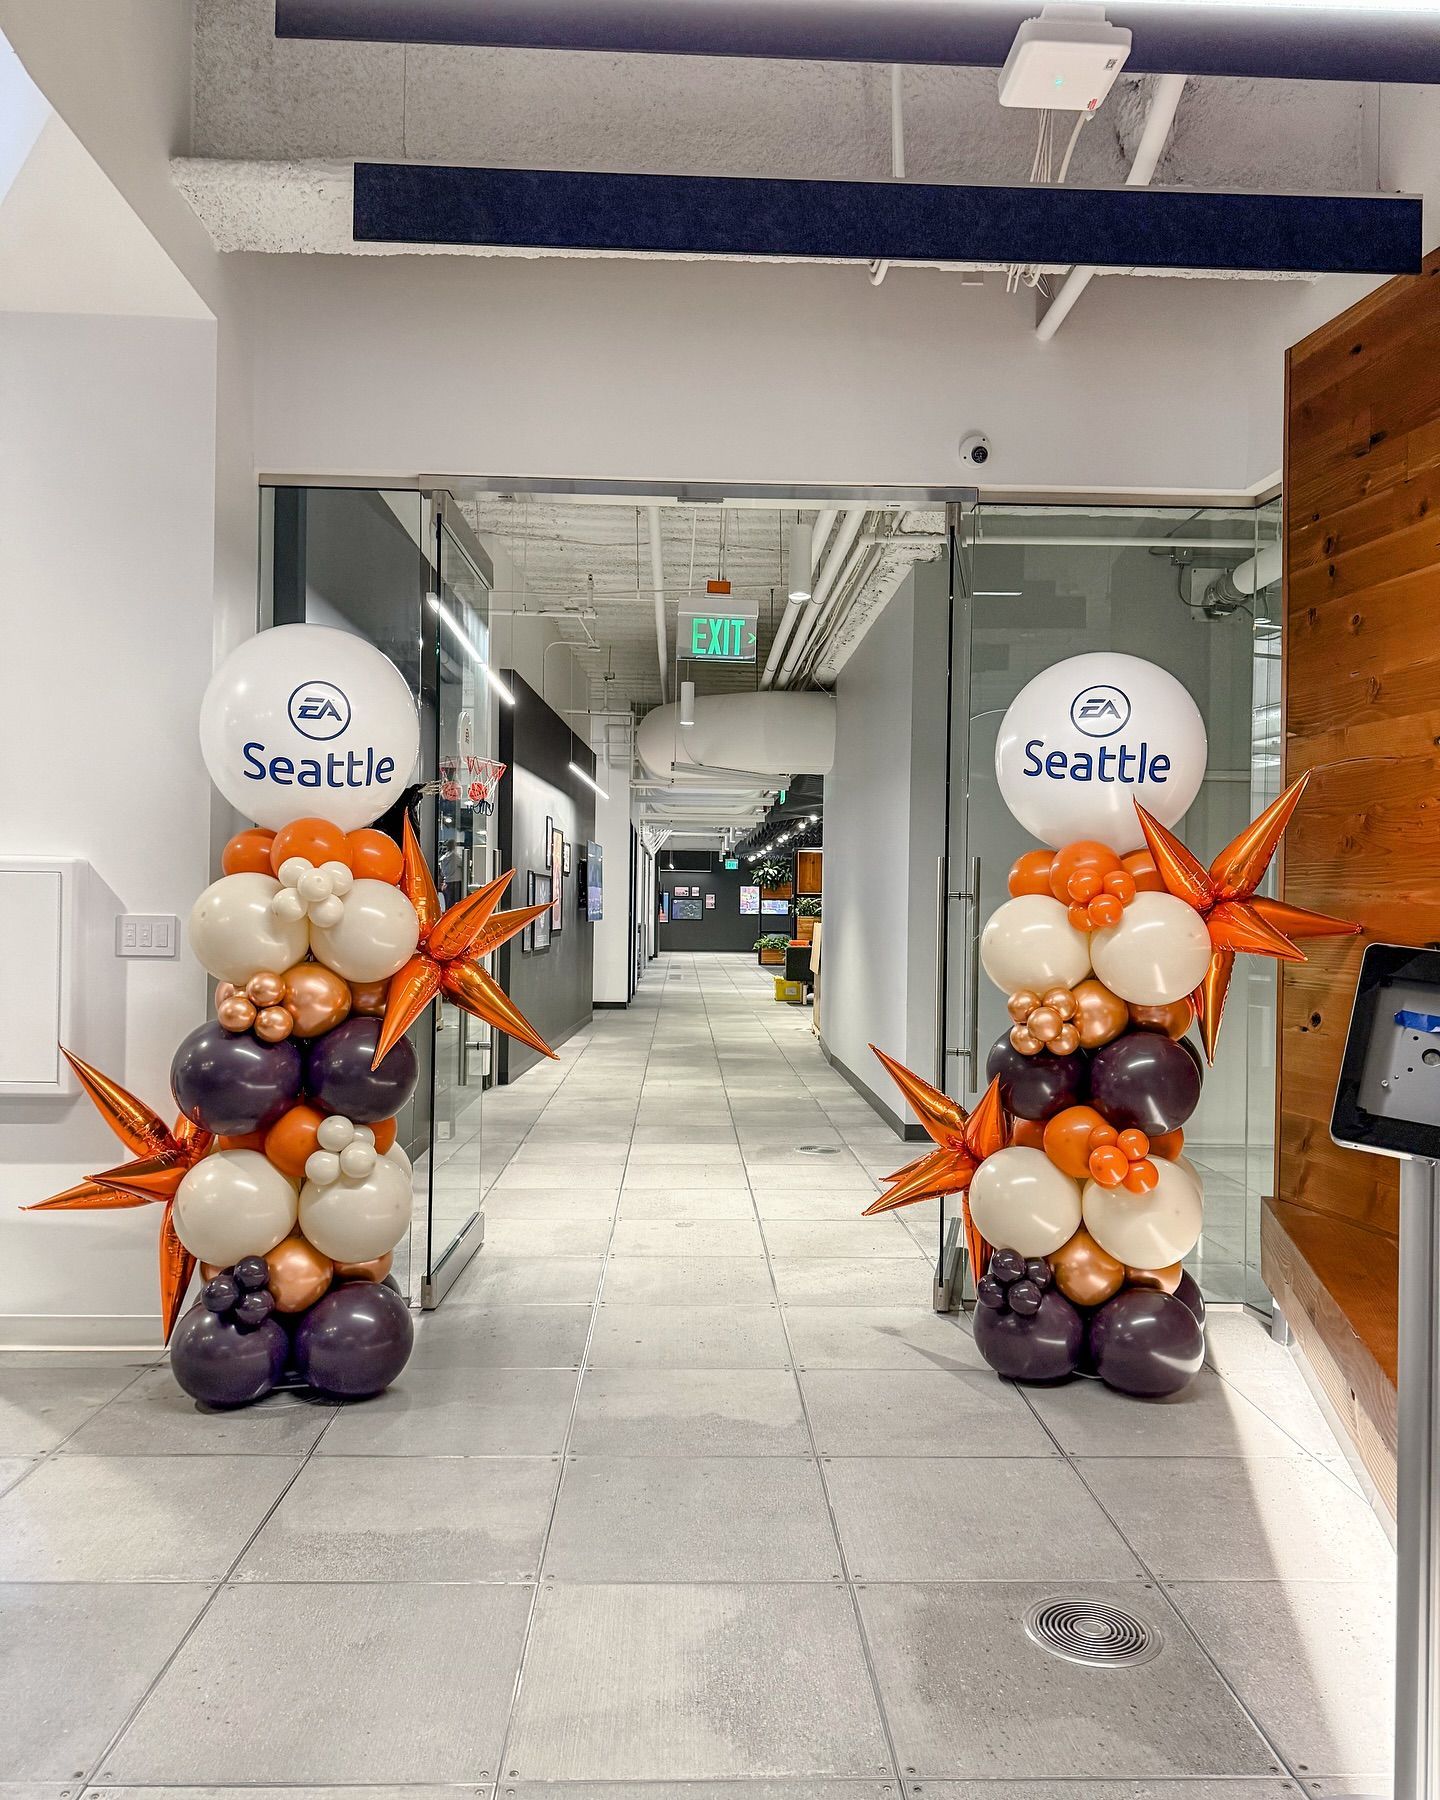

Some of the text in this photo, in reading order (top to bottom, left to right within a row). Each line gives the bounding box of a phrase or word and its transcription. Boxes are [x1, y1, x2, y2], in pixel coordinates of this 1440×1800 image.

[692, 618, 746, 656] EXIT
[298, 696, 343, 722] EA
[1079, 698, 1122, 719] EA
[243, 742, 395, 788] Seattle
[1023, 740, 1171, 784] Seattle
